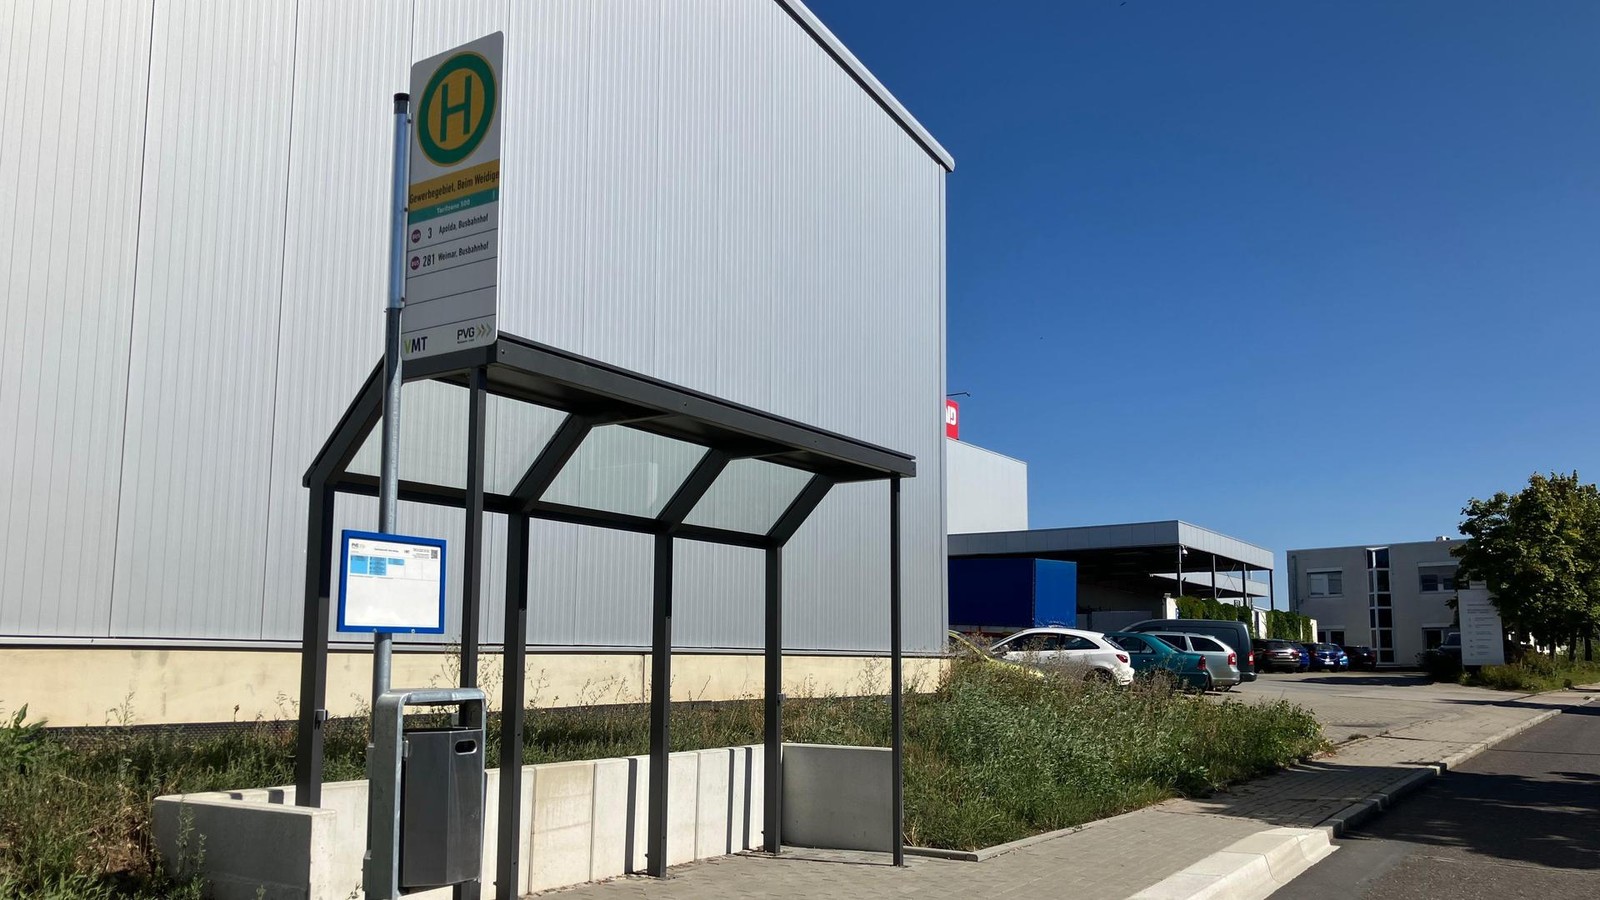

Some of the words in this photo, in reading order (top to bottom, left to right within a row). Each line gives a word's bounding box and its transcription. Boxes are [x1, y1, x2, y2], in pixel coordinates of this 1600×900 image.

[440, 74, 472, 143] H
[409, 183, 455, 204] Gewerbegebiet,
[457, 176, 474, 191] Beim
[427, 227, 433, 239] 3
[439, 222, 457, 235] Apolda,
[458, 213, 489, 229] Busbahnhof
[422, 253, 435, 267] 281
[458, 241, 489, 256] Busbahnhof
[404, 336, 428, 354] VMT
[457, 327, 475, 340] PVG
